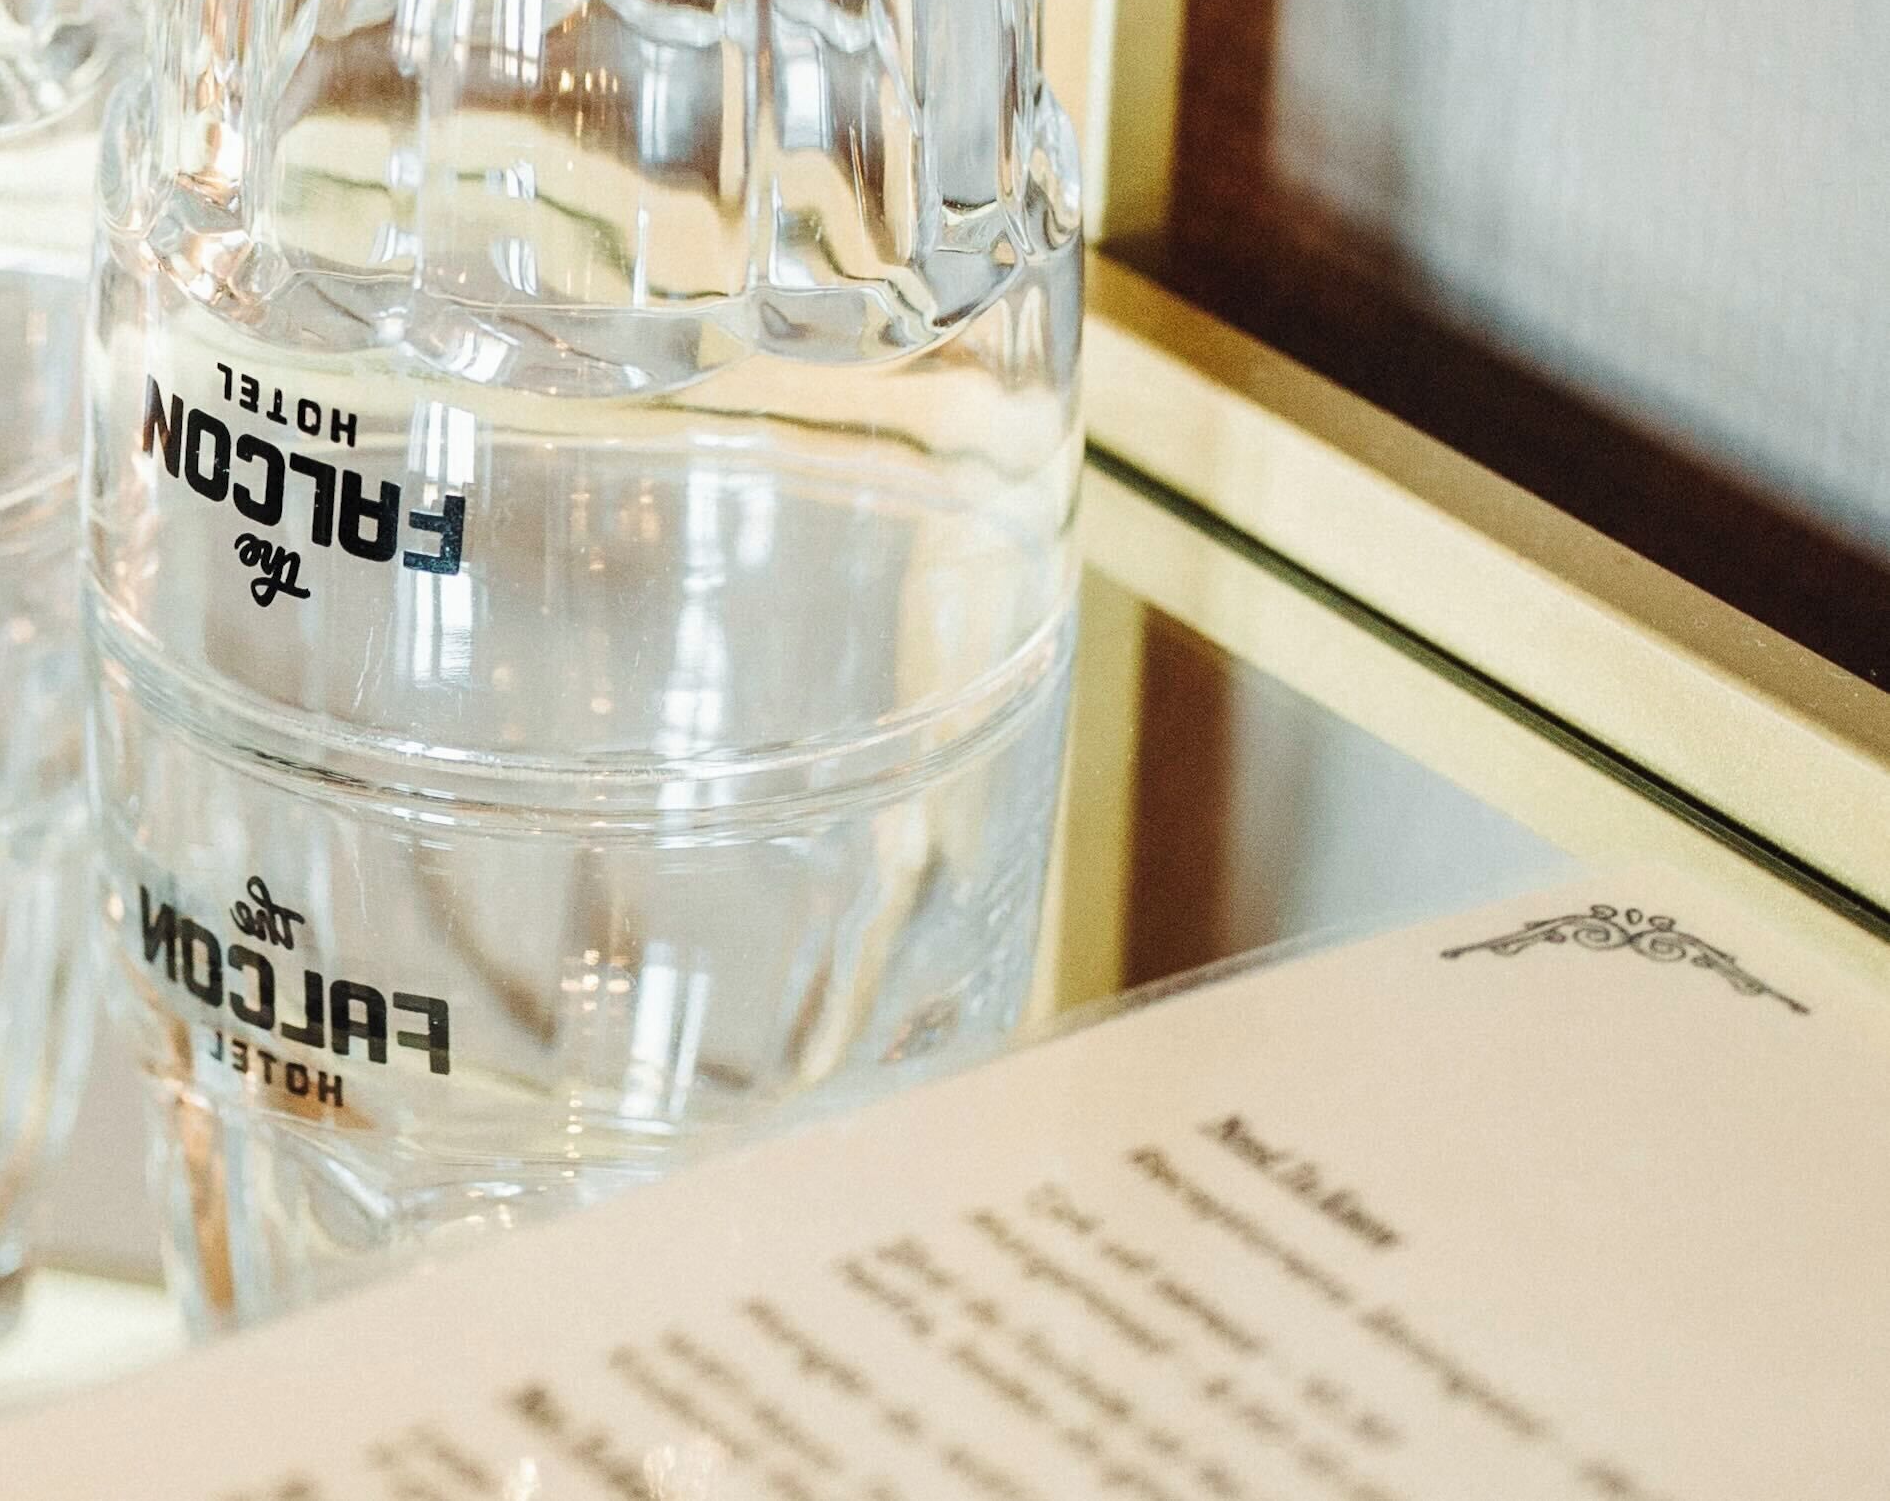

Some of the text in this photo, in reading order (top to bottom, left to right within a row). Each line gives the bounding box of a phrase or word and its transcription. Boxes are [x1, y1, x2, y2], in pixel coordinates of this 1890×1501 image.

[216, 362, 357, 447] HOTEL
[142, 374, 466, 576] FALCON
[234, 532, 310, 607] the
